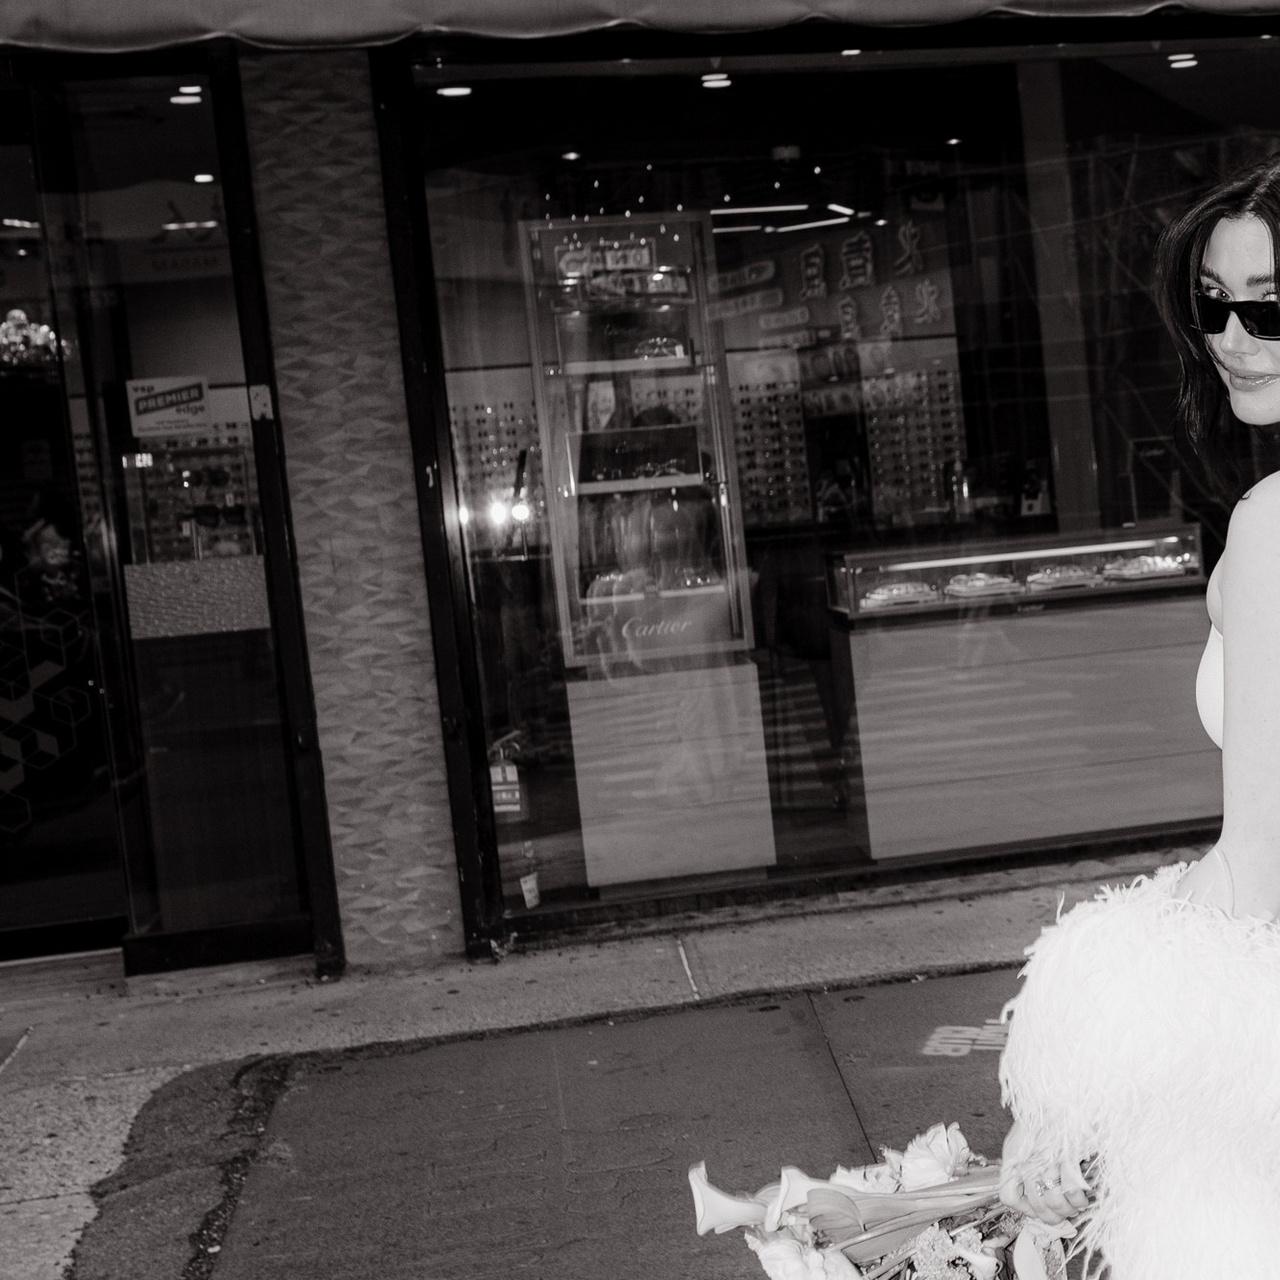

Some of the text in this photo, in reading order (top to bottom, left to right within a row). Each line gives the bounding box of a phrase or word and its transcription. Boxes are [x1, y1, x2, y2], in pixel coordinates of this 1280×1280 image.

[138, 386, 201, 412] PREMIER
[175, 403, 205, 416] edge
[621, 616, 692, 637] Cartier
